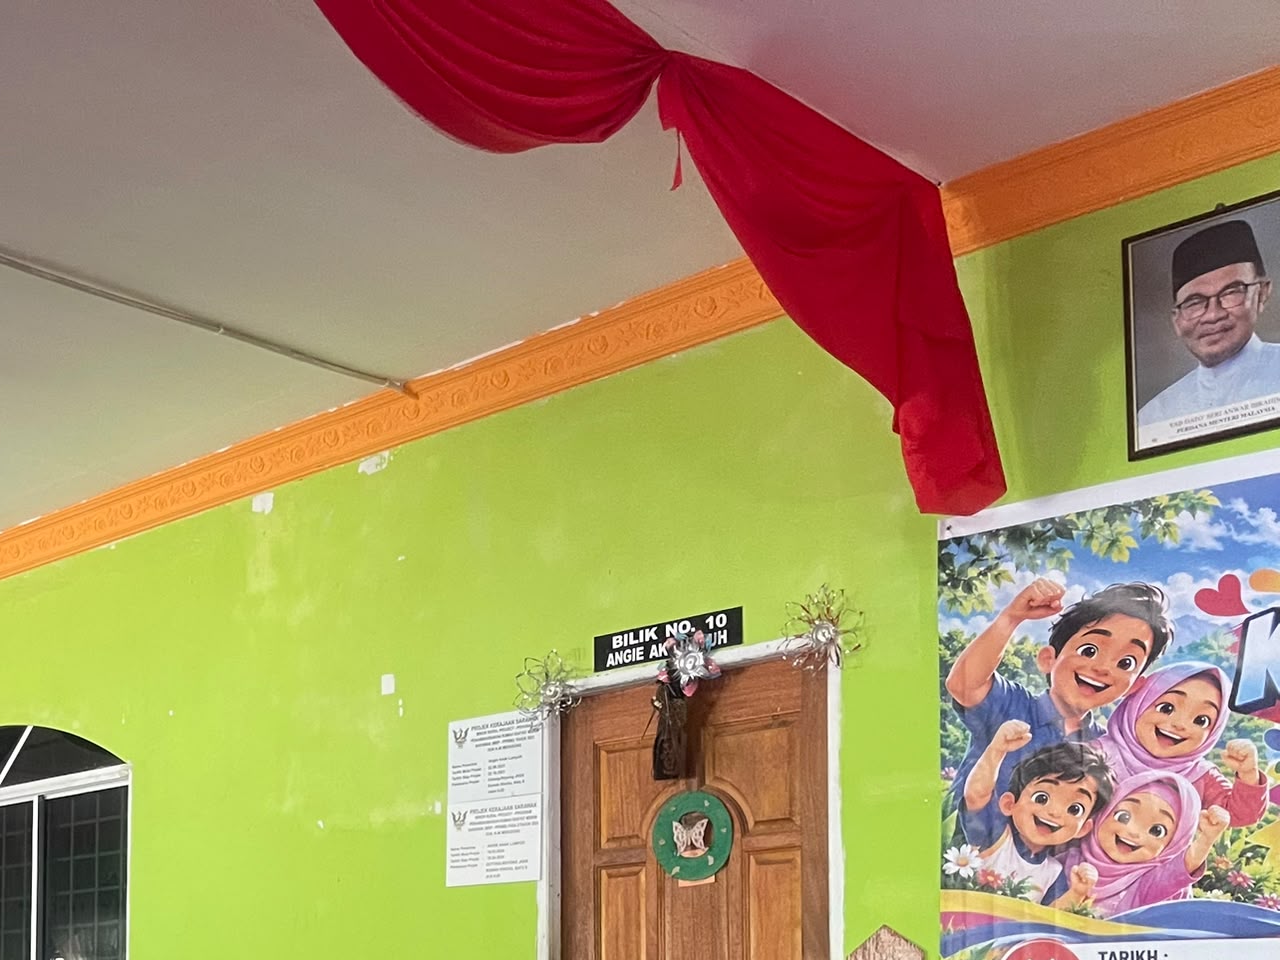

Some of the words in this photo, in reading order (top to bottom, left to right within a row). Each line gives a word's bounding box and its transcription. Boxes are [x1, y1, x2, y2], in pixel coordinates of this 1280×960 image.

[1240, 406, 1276, 419] MALAYSIA
[612, 626, 658, 649] BILIK
[665, 620, 696, 638] NO.
[705, 613, 728, 630] 10
[606, 646, 645, 668] ANGIE
